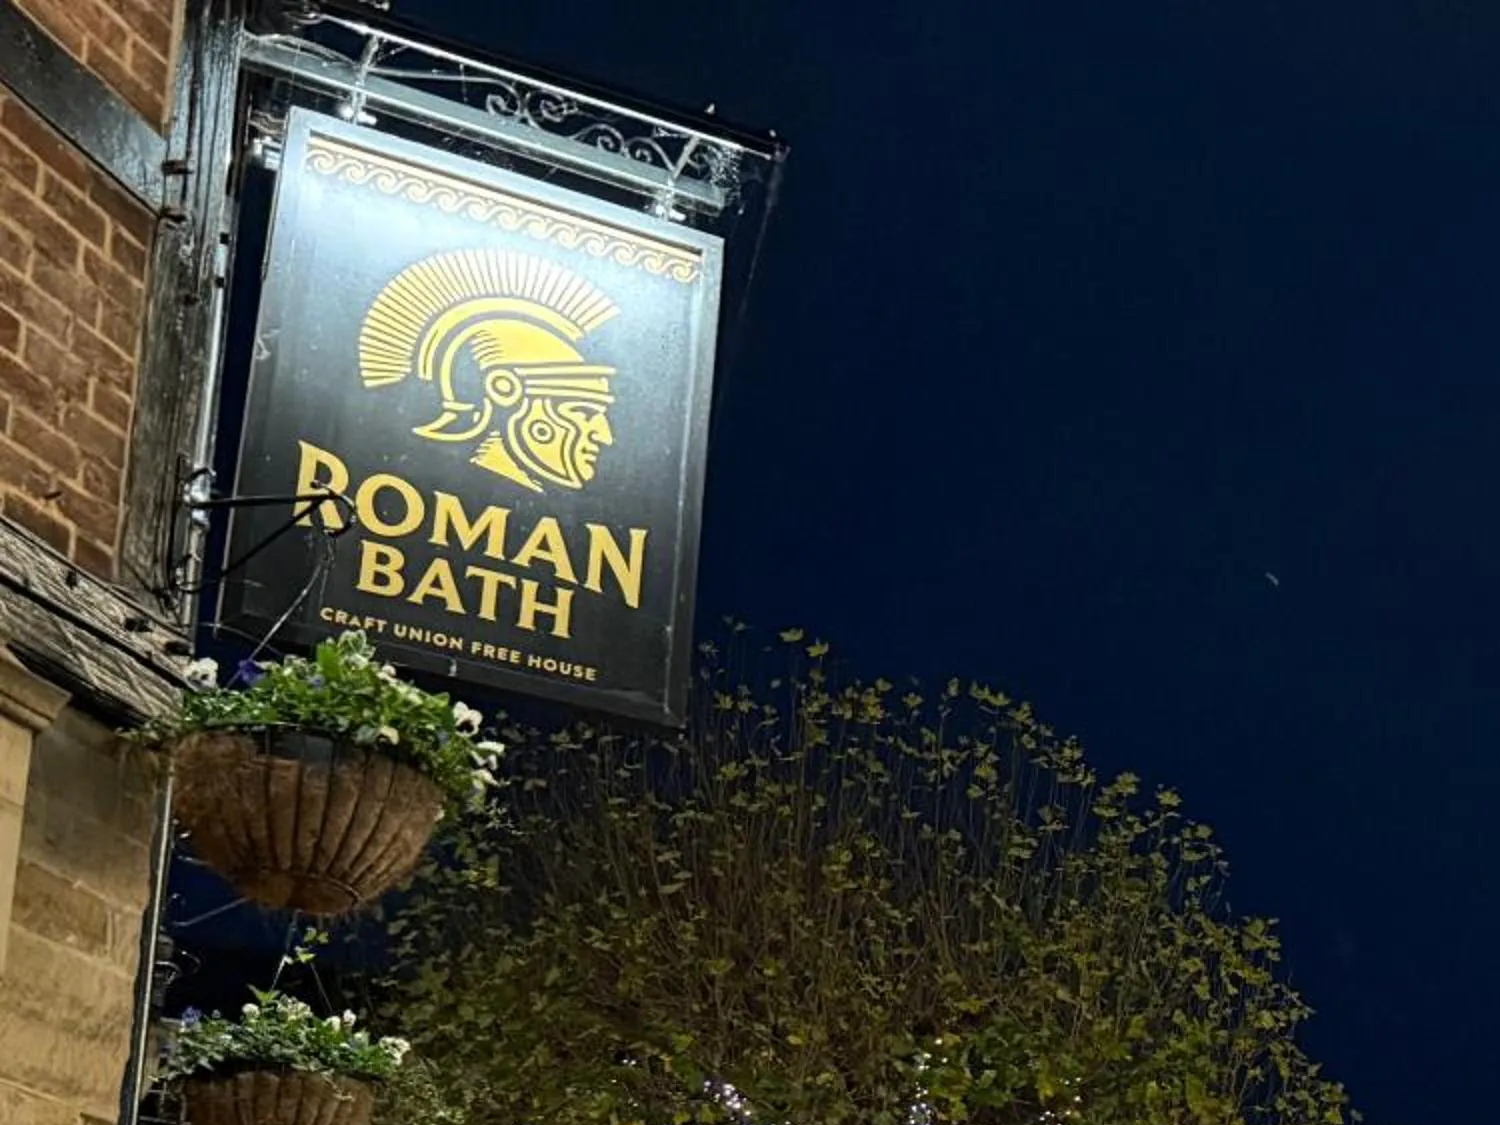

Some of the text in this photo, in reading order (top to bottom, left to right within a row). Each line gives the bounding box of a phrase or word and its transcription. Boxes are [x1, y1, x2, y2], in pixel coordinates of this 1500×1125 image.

[293, 440, 648, 609] ROMAN
[355, 539, 575, 639] BATH
[320, 607, 598, 682] CRAFT UNION FREE HOUSE
